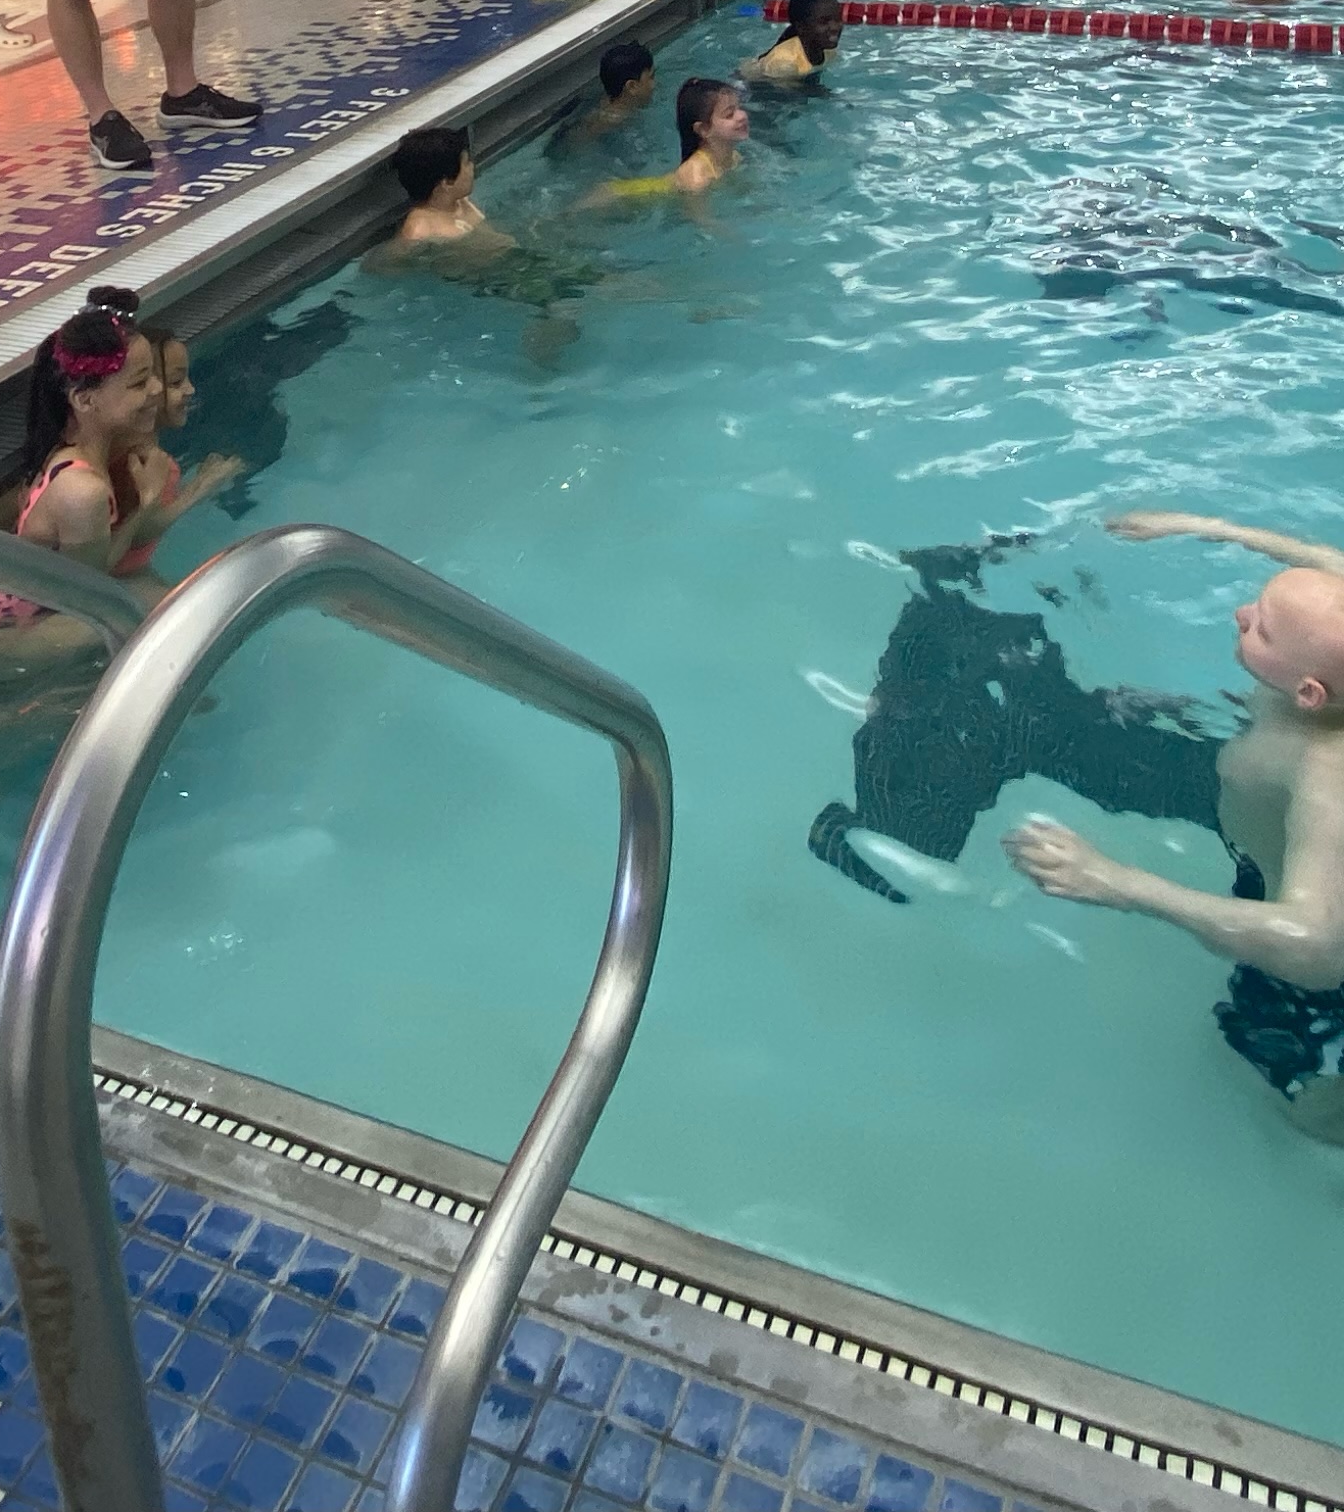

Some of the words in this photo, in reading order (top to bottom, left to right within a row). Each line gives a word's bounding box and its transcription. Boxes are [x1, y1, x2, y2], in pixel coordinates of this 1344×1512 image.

[370, 86, 410, 98] 3
[284, 100, 387, 142] FEET
[95, 161, 267, 239] INCHES
